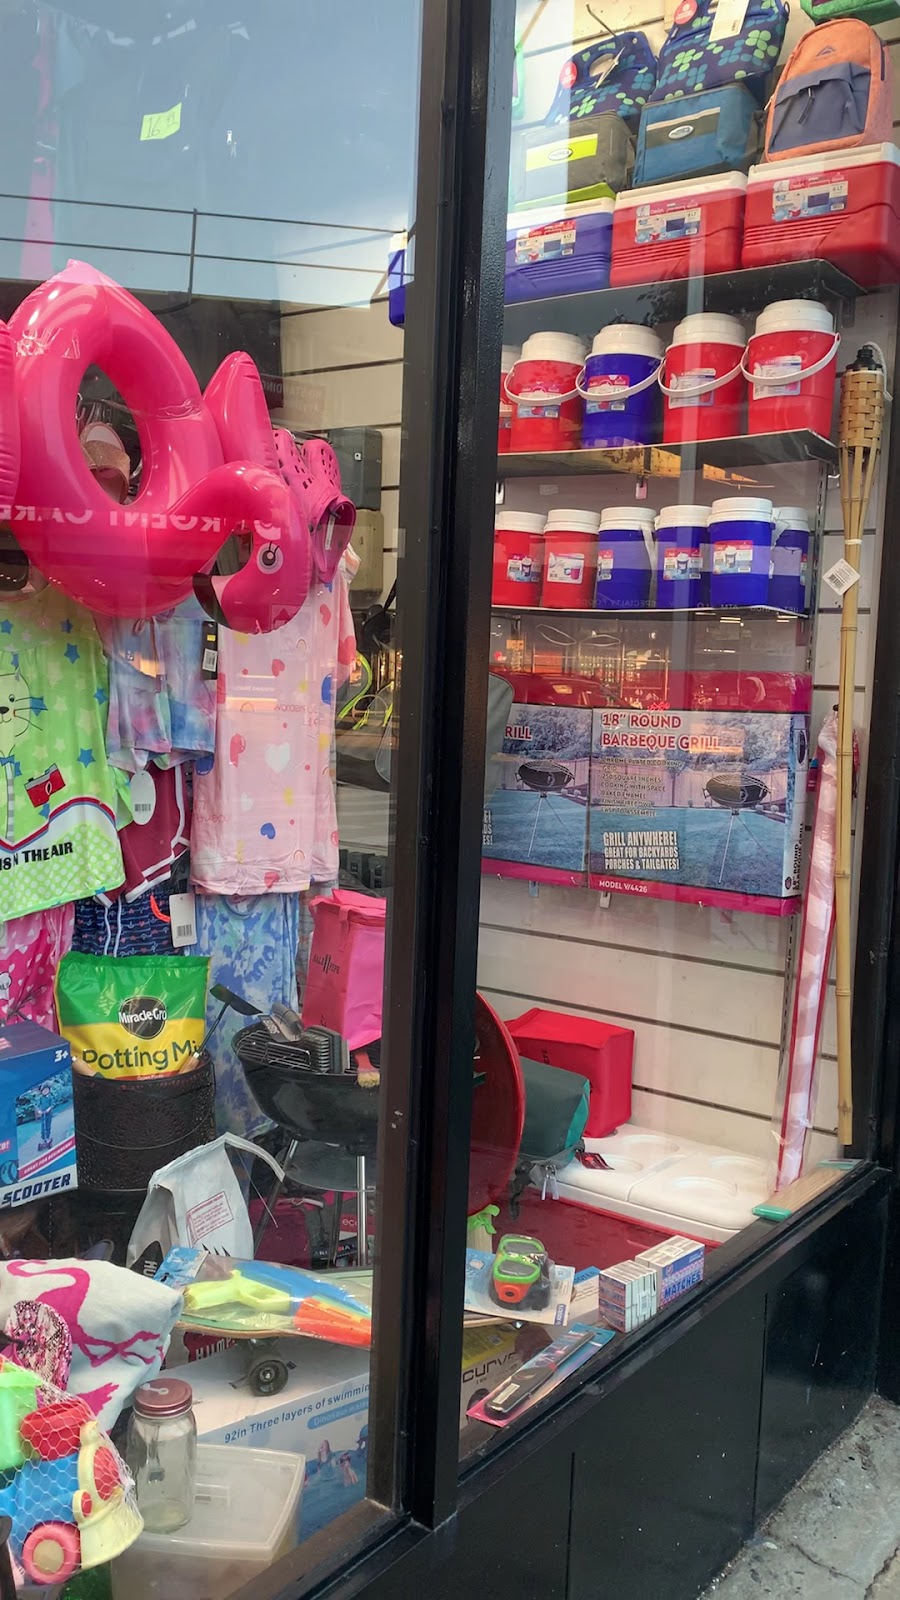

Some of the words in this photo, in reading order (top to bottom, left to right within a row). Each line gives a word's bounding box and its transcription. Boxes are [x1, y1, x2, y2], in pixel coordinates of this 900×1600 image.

[630, 714, 682, 728] ROUND
[505, 726, 531, 739] RILL
[602, 733, 676, 749] BARBEQUE
[679, 736, 720, 750] GRILL
[600, 781, 628, 789] COOKING
[603, 831, 626, 847] GRILL
[627, 830, 677, 846] ANYWHERE!
[22, 848, 50, 863] THE
[50, 841, 74, 857] AIR
[604, 846, 624, 858] GREAT
[625, 846, 638, 858] FOR
[639, 846, 678, 858] BACKYARDS
[605, 859, 634, 870] PORCHES
[642, 859, 680, 870] TAILGATES!
[599, 880, 623, 890] MODEL
[54, 1050, 69, 1063] 3+
[82, 1044, 169, 1071] Potting
[171, 1039, 201, 1062] Mi
[2, 1173, 71, 1206] SCOOTER
[224, 1429, 247, 1444] 92in
[249, 1417, 280, 1434] Three
[281, 1405, 313, 1422] layers
[315, 1397, 327, 1410] of
